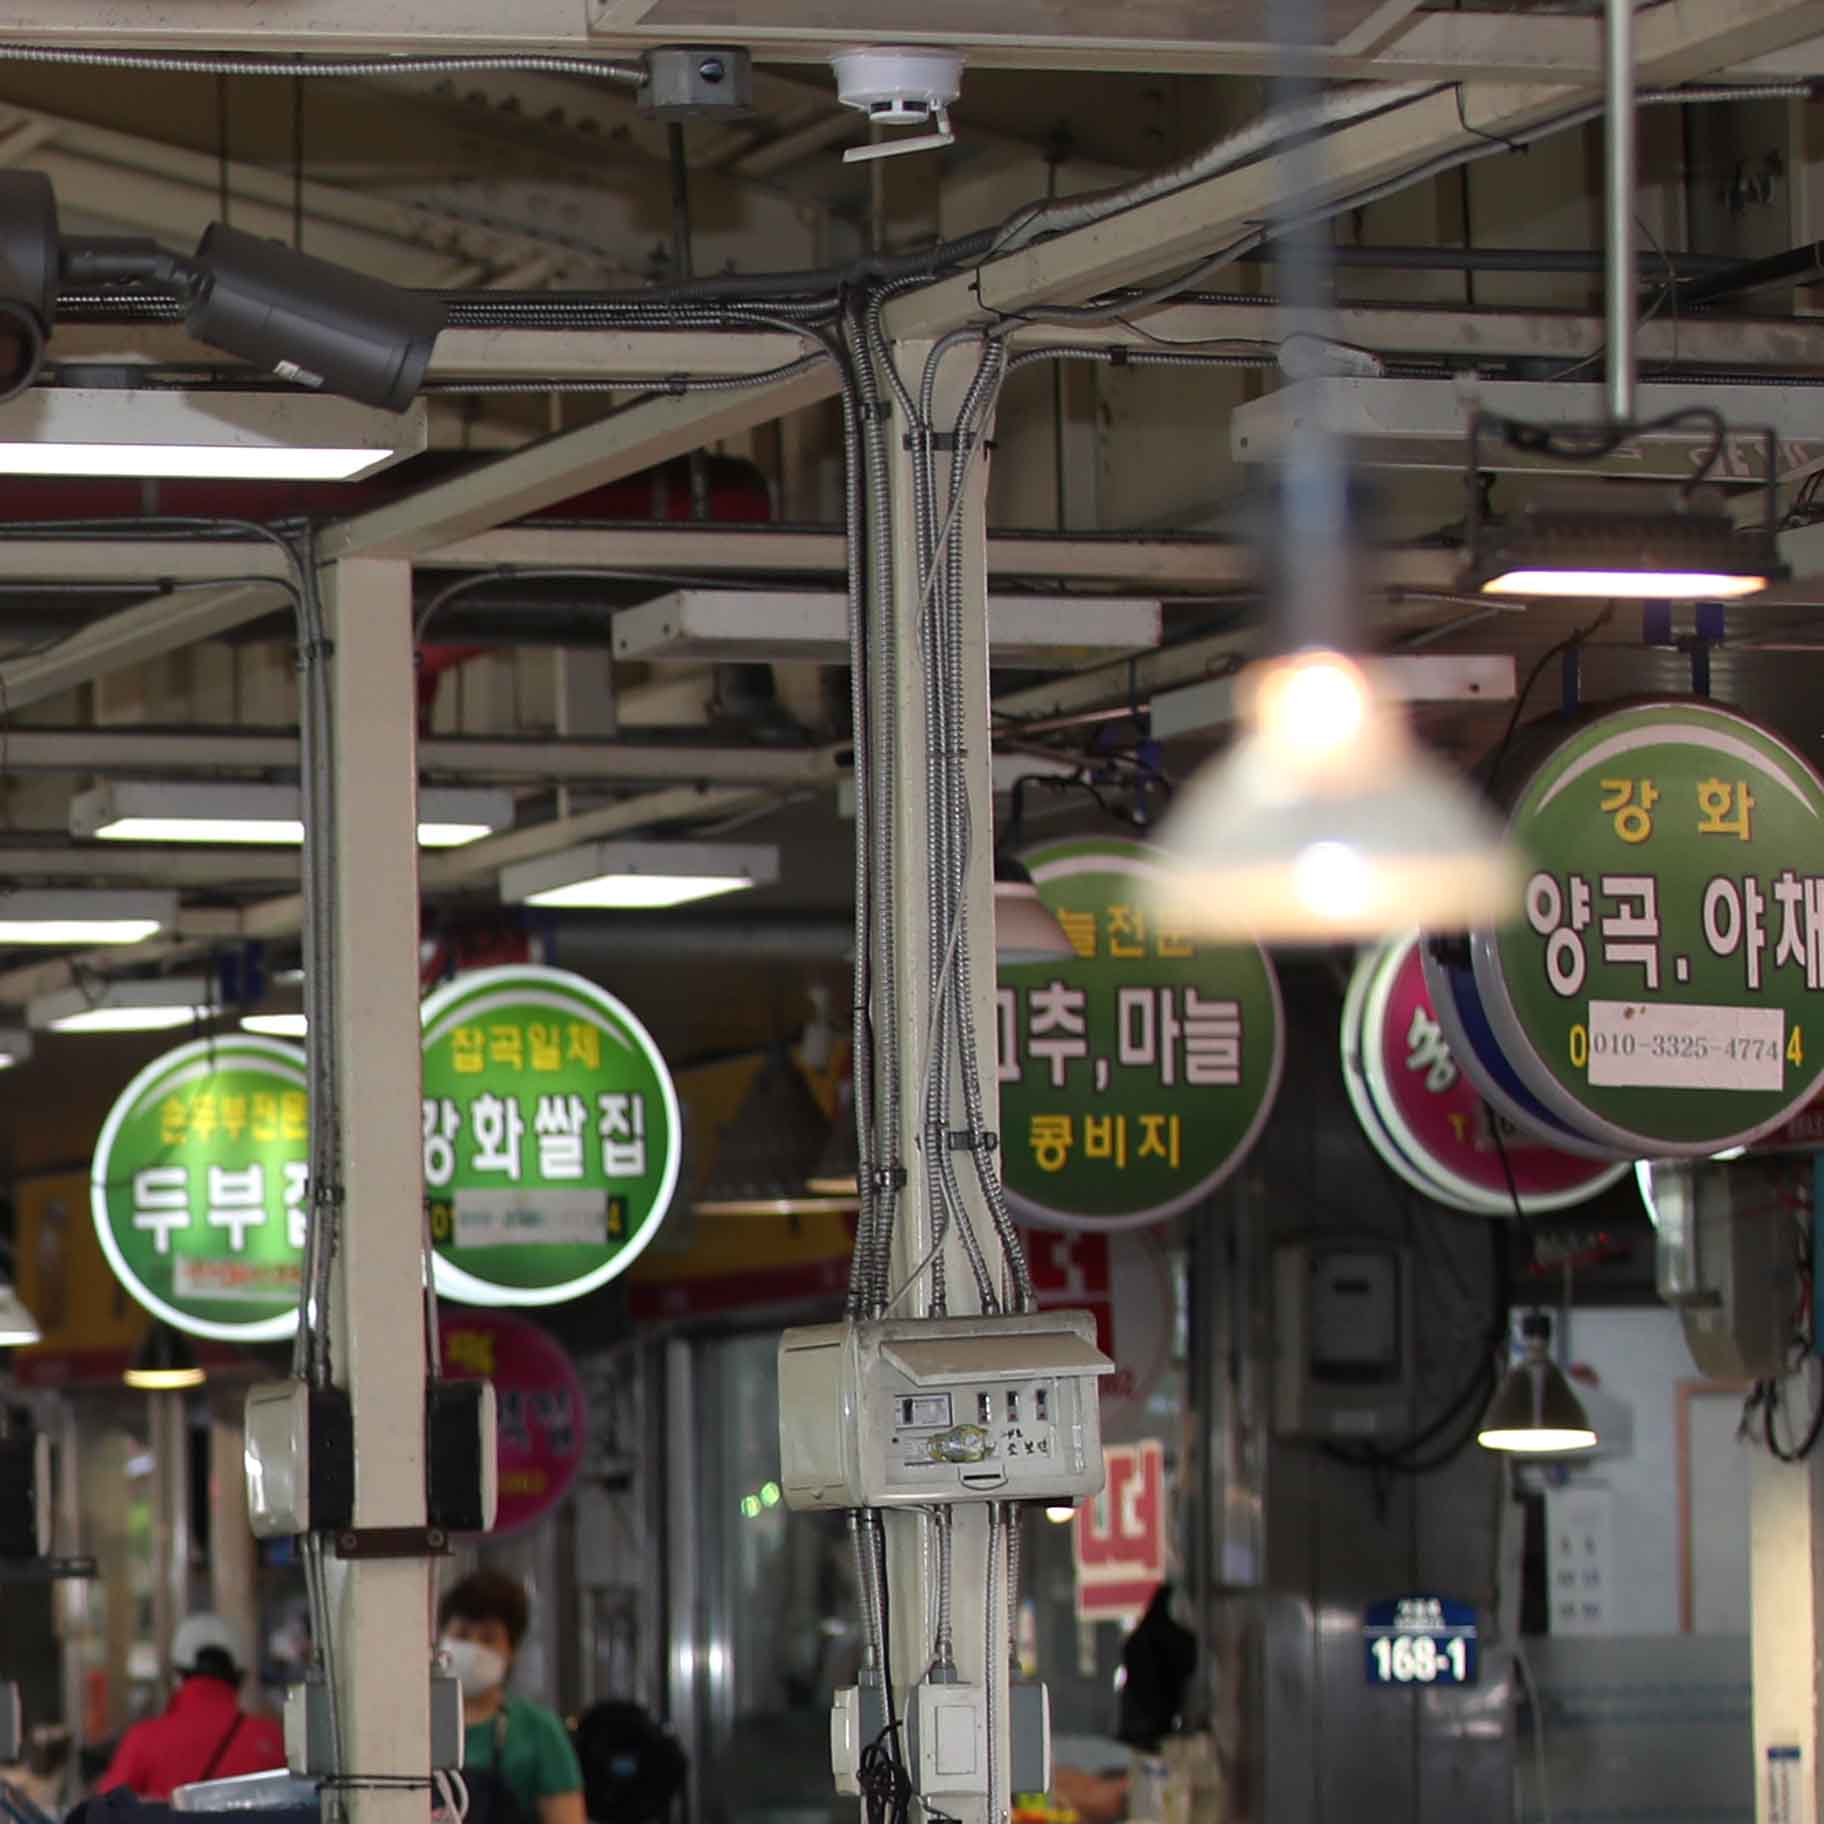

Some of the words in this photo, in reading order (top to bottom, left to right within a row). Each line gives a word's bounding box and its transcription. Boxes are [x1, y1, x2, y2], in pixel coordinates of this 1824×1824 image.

[1592, 1032, 1780, 1062] 010-3325-4774
[423, 1091, 647, 1187] 강화쌀집
[1028, 1113, 1181, 1173] 콩비지
[1371, 1635, 1466, 1682] 168-1
